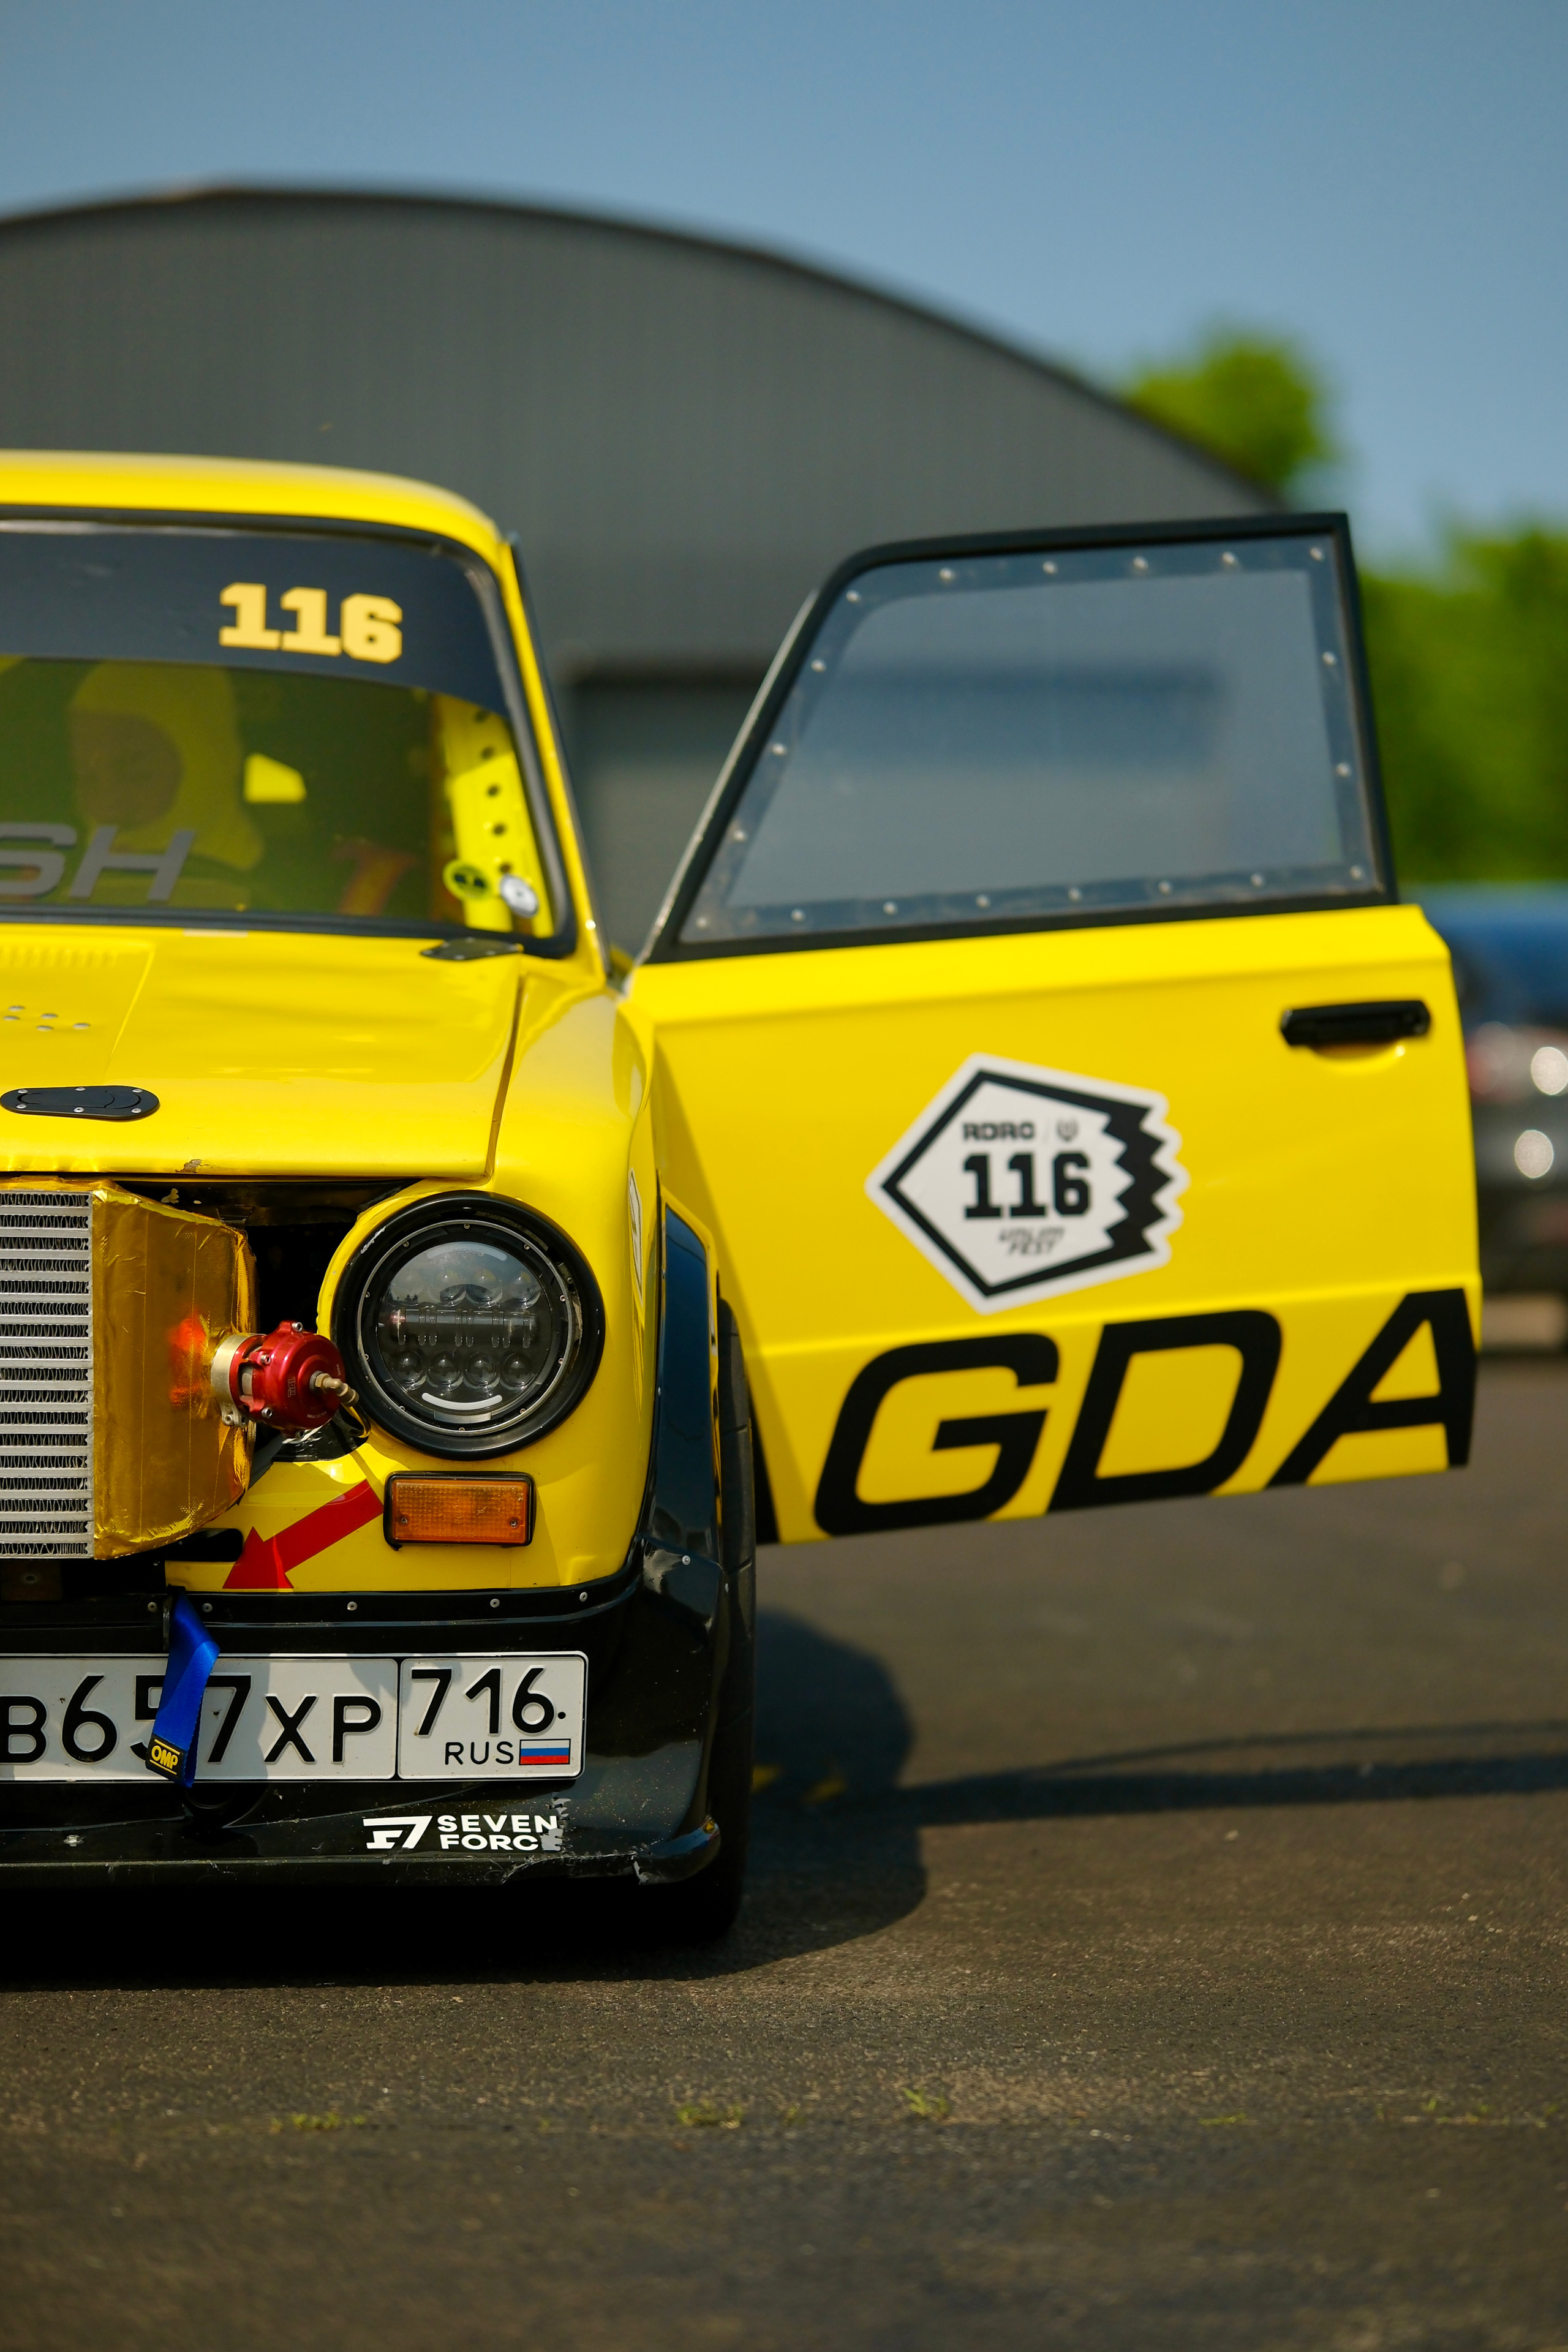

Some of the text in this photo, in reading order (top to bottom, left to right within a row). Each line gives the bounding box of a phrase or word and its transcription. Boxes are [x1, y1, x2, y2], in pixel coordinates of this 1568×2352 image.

[219, 582, 403, 663] 116
[964, 1152, 1090, 1218] 116
[411, 1667, 555, 1735] 716
[151, 1745, 178, 1769] OMP
[445, 1740, 514, 1765] RUS
[437, 1815, 557, 1833] SEVEN
